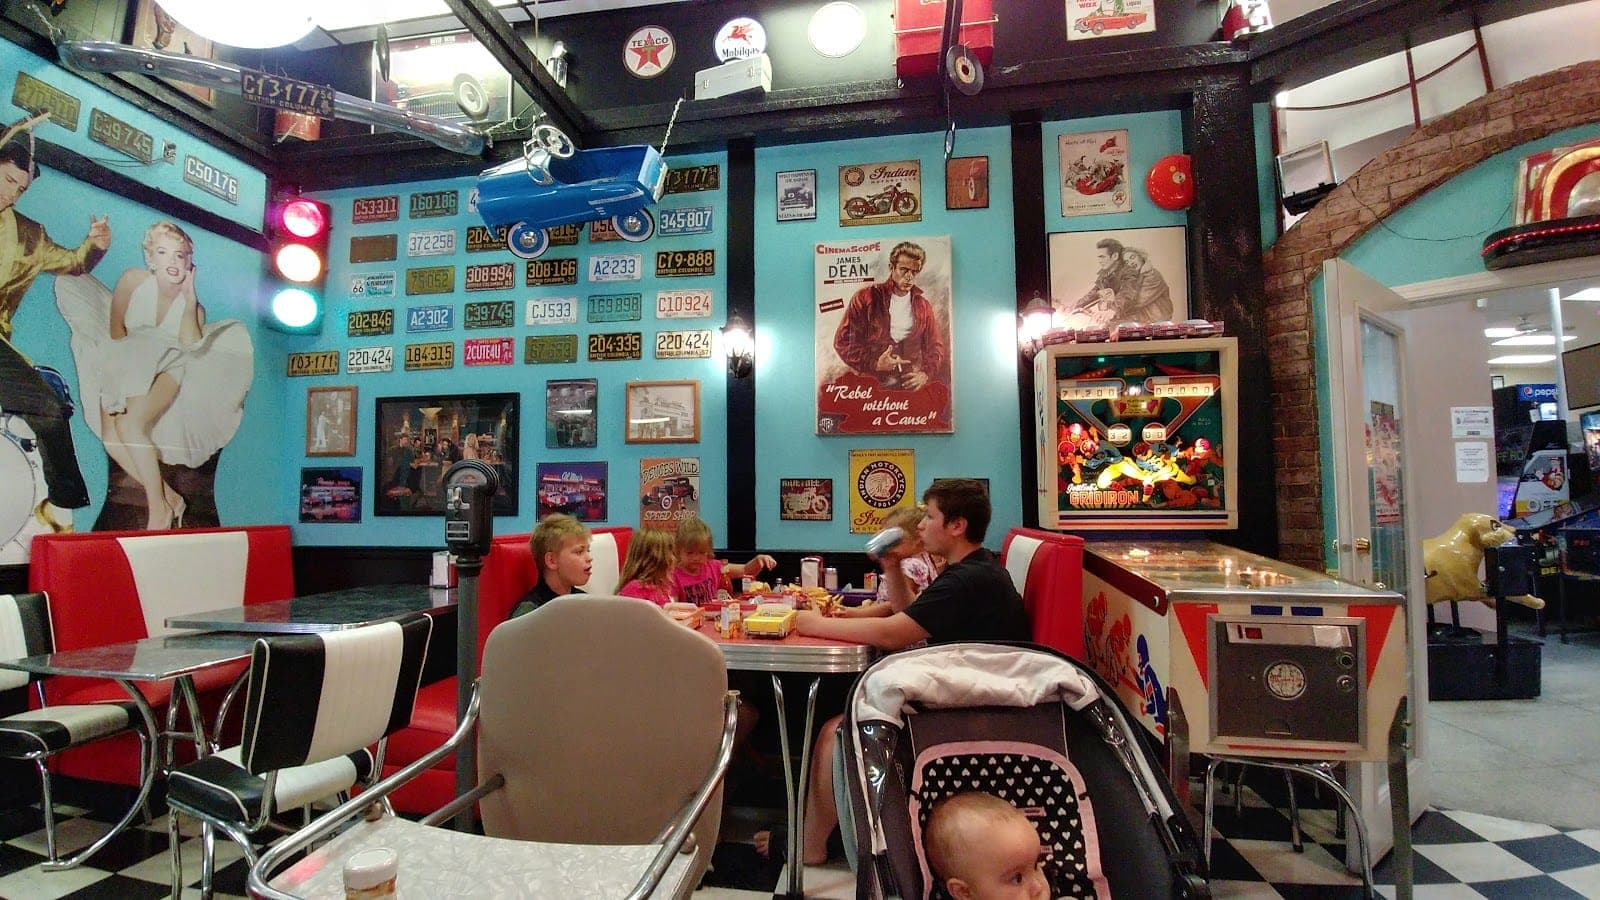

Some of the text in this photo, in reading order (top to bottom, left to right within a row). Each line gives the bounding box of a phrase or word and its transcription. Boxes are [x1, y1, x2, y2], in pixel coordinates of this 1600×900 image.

[631, 37, 669, 48] TEXACO
[722, 46, 760, 58] Mobilgas
[869, 165, 918, 180] Indian
[836, 256, 861, 265] JAMES
[828, 263, 869, 279] DEAN
[466, 344, 501, 361] 2CUTE4U
[863, 396, 910, 412] without
[872, 417, 881, 426] a
[675, 462, 698, 474] WILD
[1069, 490, 1139, 509] GRIDIRON
[644, 510, 671, 521] SPEED
